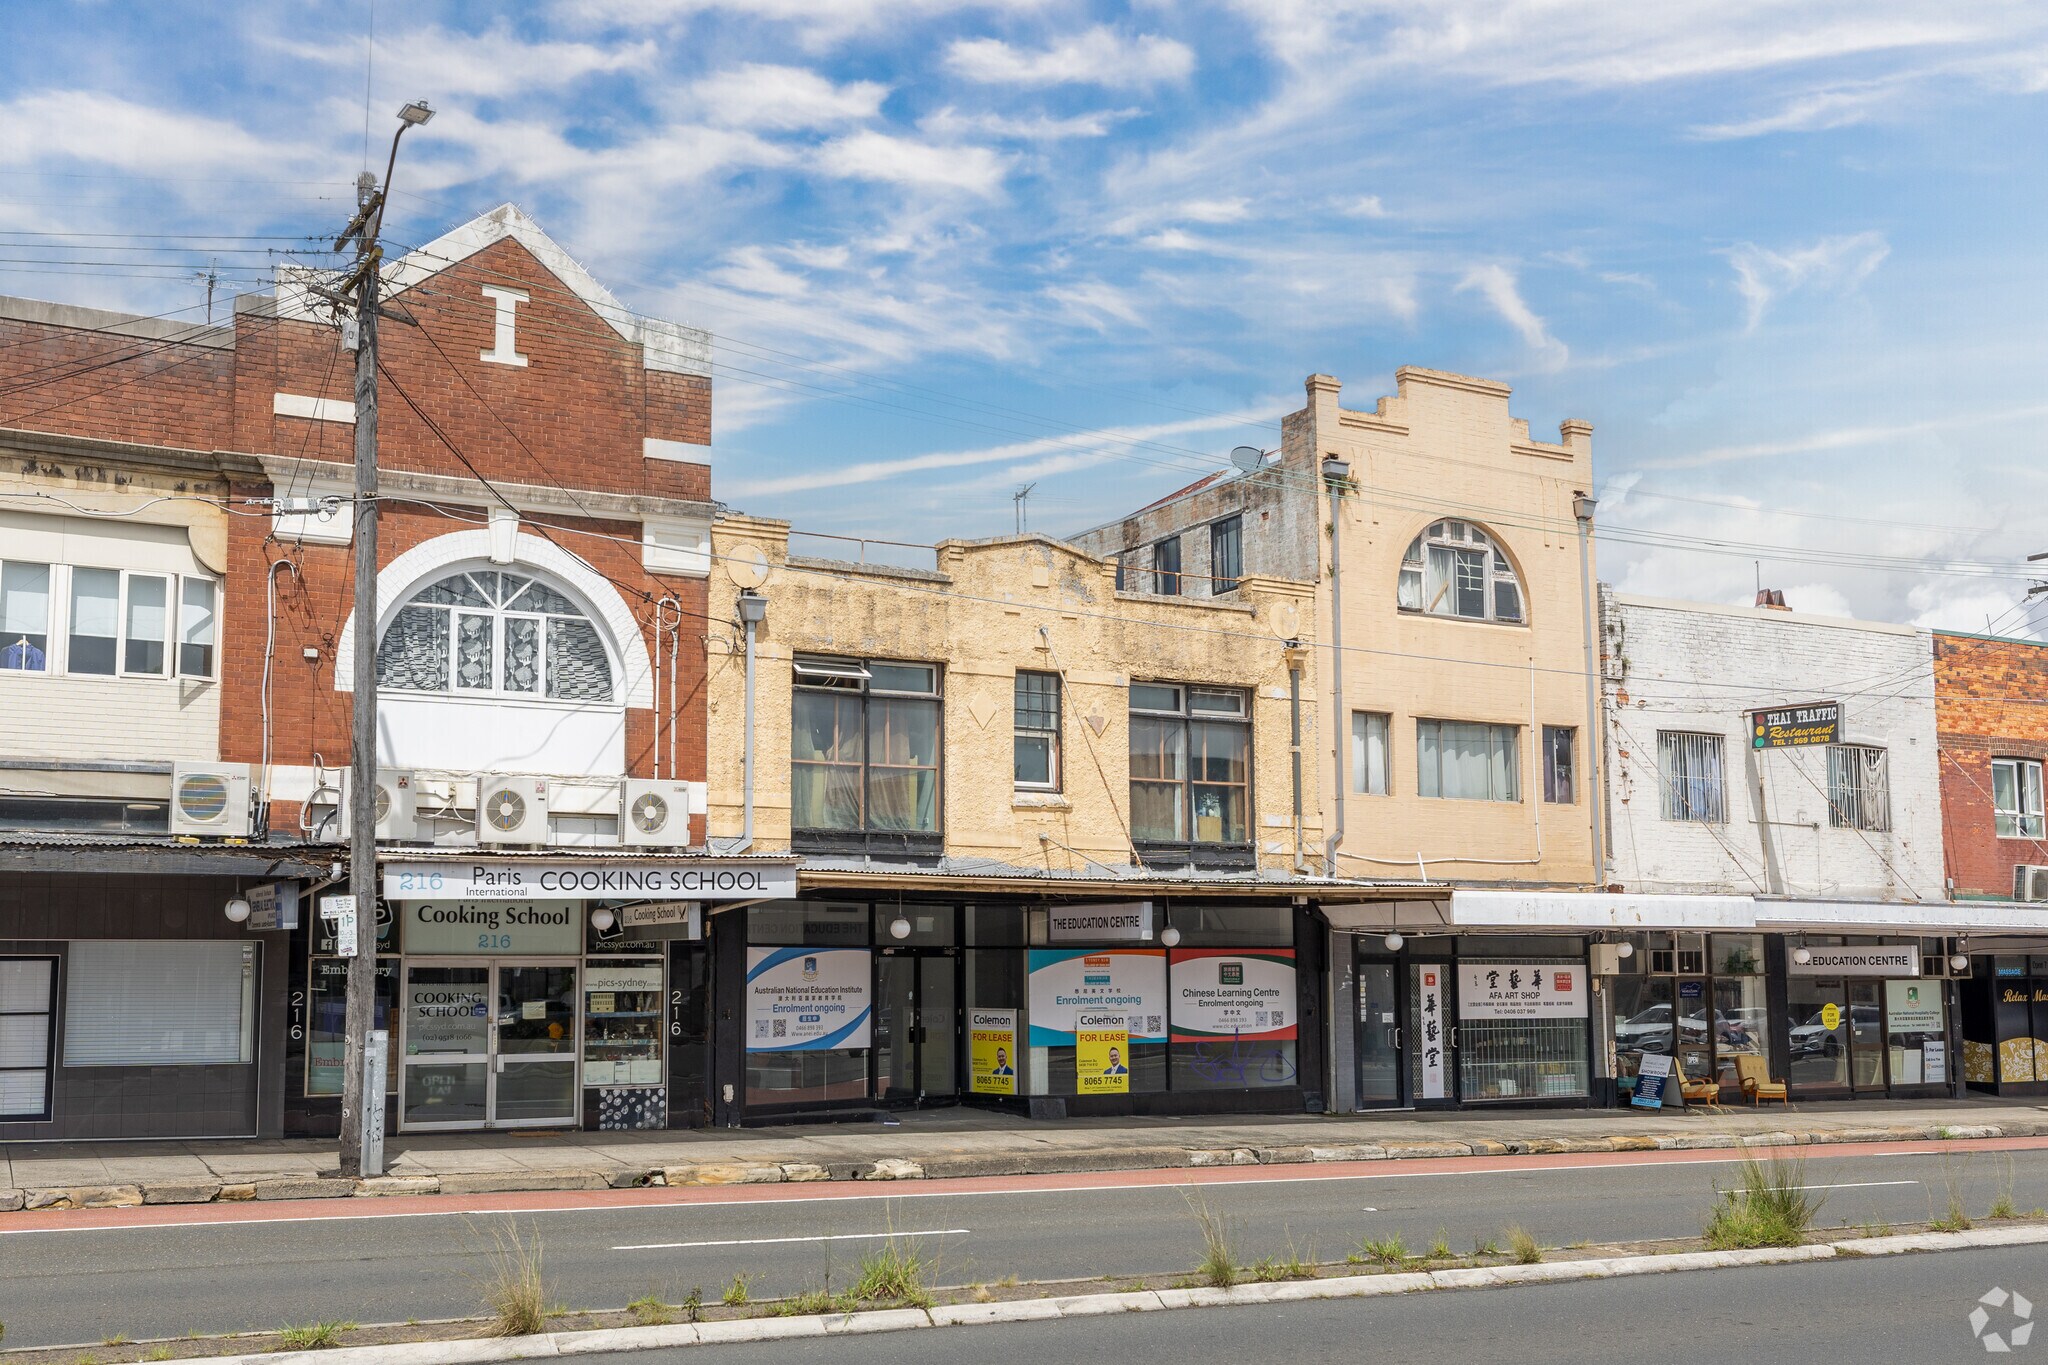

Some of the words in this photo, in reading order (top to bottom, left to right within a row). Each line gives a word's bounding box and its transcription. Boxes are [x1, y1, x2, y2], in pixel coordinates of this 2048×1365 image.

[1767, 712, 1791, 726] THAI
[1796, 706, 1837, 722] TRAFFIC
[1769, 724, 1835, 739] Restaurant
[1793, 737, 1808, 745] 569
[400, 872, 443, 890] 216
[473, 866, 521, 885] Paris
[540, 871, 661, 891] COOKING
[670, 871, 768, 891] SCHOOL
[466, 887, 528, 896] International
[418, 905, 499, 929] Cooking
[506, 906, 569, 925] School
[634, 908, 656, 922] Cooking
[656, 905, 675, 919] School
[341, 916, 354, 927] 1P
[1053, 918, 1067, 929] THE
[1068, 917, 1108, 929] EDUCATION
[1110, 916, 1139, 928] CENTRE
[478, 934, 511, 948] 216
[1813, 956, 1866, 966] EDUCATION
[1868, 955, 1908, 966] CENTRE
[754, 986, 785, 994] Australian
[785, 986, 810, 994] National
[810, 986, 839, 994] Education
[840, 986, 862, 994] Institute
[1182, 988, 1215, 998] Chinese
[1217, 988, 1252, 998] Learning
[1253, 988, 1280, 997] Centre
[1521, 991, 1541, 999] SHOP
[2003, 988, 2029, 1003] Relax
[414, 992, 482, 1004] COOKING
[1056, 996, 1103, 1005] Enrolment
[1105, 995, 1141, 1005] ongoing
[772, 1003, 813, 1013] Enrolment
[814, 1003, 846, 1014] ongoing
[1236, 1000, 1264, 1008] ongoing
[290, 991, 303, 1040] 216
[419, 1006, 476, 1017] SCHOOL
[671, 990, 682, 1036] 216
[973, 1015, 1011, 1025] Colemon
[1081, 1015, 1124, 1025] Colemon
[418, 1023, 476, 1031] picssyd.com.au
[422, 1034, 437, 1042] (02)
[438, 1034, 455, 1042] 9518
[973, 1033, 987, 1041] FOR
[988, 1033, 1012, 1042] LEASE
[1080, 1034, 1097, 1042] FOR
[1099, 1033, 1125, 1042] LEASE
[976, 1075, 992, 1085] 8065
[993, 1077, 1009, 1086] 7745
[1084, 1077, 1102, 1086] 8065
[1104, 1076, 1122, 1085] 7745
